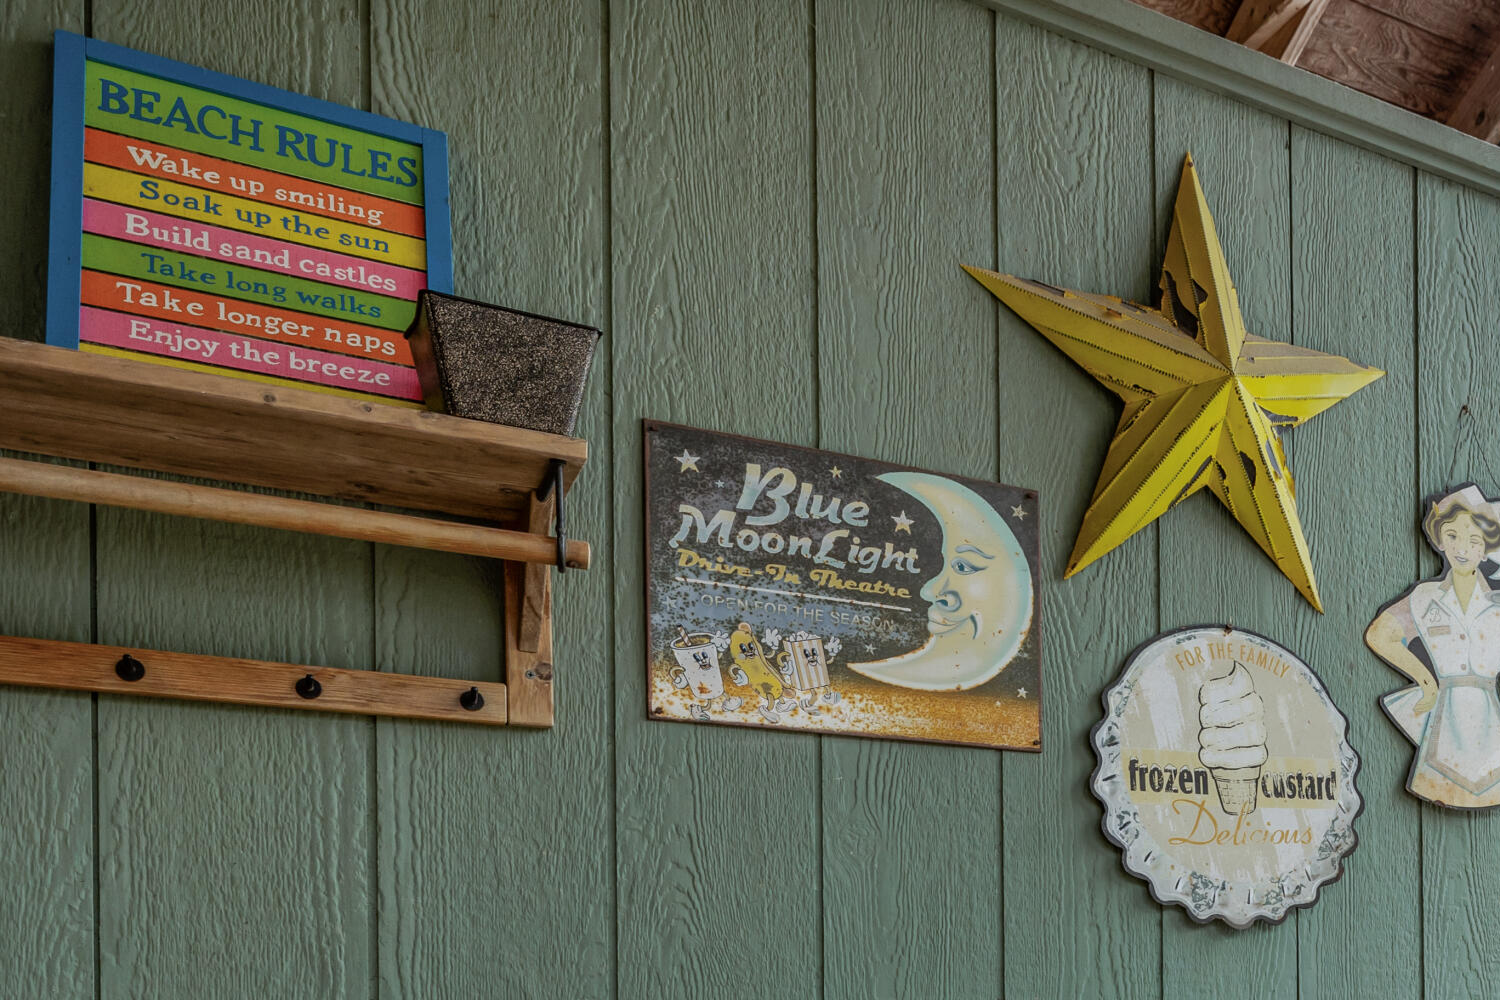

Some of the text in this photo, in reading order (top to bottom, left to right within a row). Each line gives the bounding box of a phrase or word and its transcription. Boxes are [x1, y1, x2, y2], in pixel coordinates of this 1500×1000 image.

[97, 78, 419, 188] BEACH RULES
[127, 145, 385, 226] Wake up smiling
[139, 181, 390, 254] Soak up the sun
[125, 213, 397, 292] Build sand castles
[141, 253, 382, 319] Take long walks
[116, 282, 396, 357] Take longer naps
[129, 320, 391, 387] Enjoy the breeze
[735, 463, 870, 528] Blue
[677, 548, 913, 598] Drive-In Theatre
[701, 594, 896, 631] OPEN FOR THE SEASON
[1175, 642, 1291, 679] FOR THE FAMILY
[1128, 755, 1337, 802] frozen custard
[1168, 798, 1313, 846] Delicious
